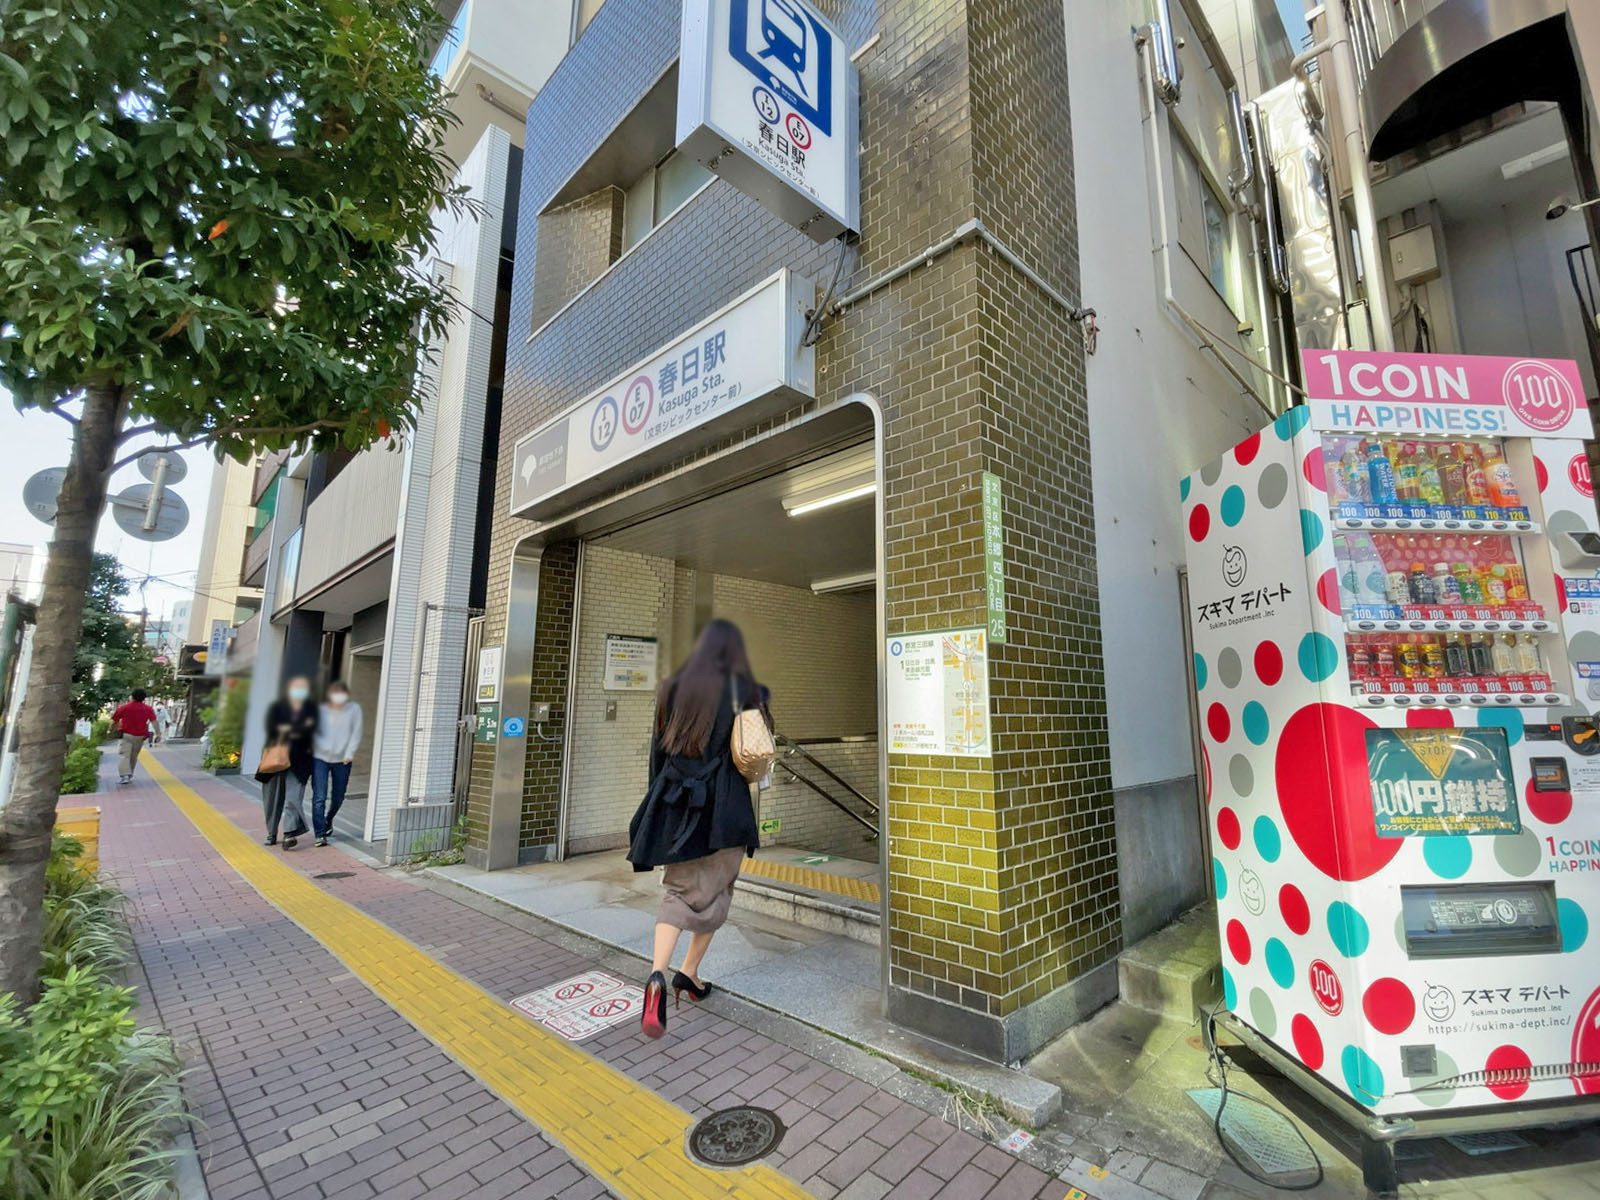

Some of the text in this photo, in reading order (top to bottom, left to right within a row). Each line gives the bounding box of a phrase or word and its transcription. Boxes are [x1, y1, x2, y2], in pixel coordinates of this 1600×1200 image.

[761, 101, 774, 119] 12
[758, 119, 806, 170] 春日駅
[792, 127, 805, 142] 07
[758, 137, 789, 166] Kasuga
[658, 329, 726, 399] 春日駅
[635, 386, 641, 403] E
[658, 373, 725, 417] Kasuga Sta.
[1514, 374, 1562, 408] 100
[629, 400, 646, 423] 07
[1331, 403, 1508, 432] HAPPINESS!
[598, 420, 611, 441] 12
[1197, 582, 1292, 623] スキマ デパート
[991, 619, 1004, 637] 25
[1209, 621, 1227, 631] Sukima
[1228, 612, 1262, 626] Department
[1420, 745, 1448, 756] STOP
[1370, 778, 1508, 817] 100円維持
[1312, 965, 1338, 1001] 100
[1461, 984, 1571, 1006] スキマ デパート
[1470, 1008, 1499, 1017] Sukima
[1500, 1005, 1546, 1016] Department
[1427, 1015, 1572, 1036] https://sukima-dept.inc/
